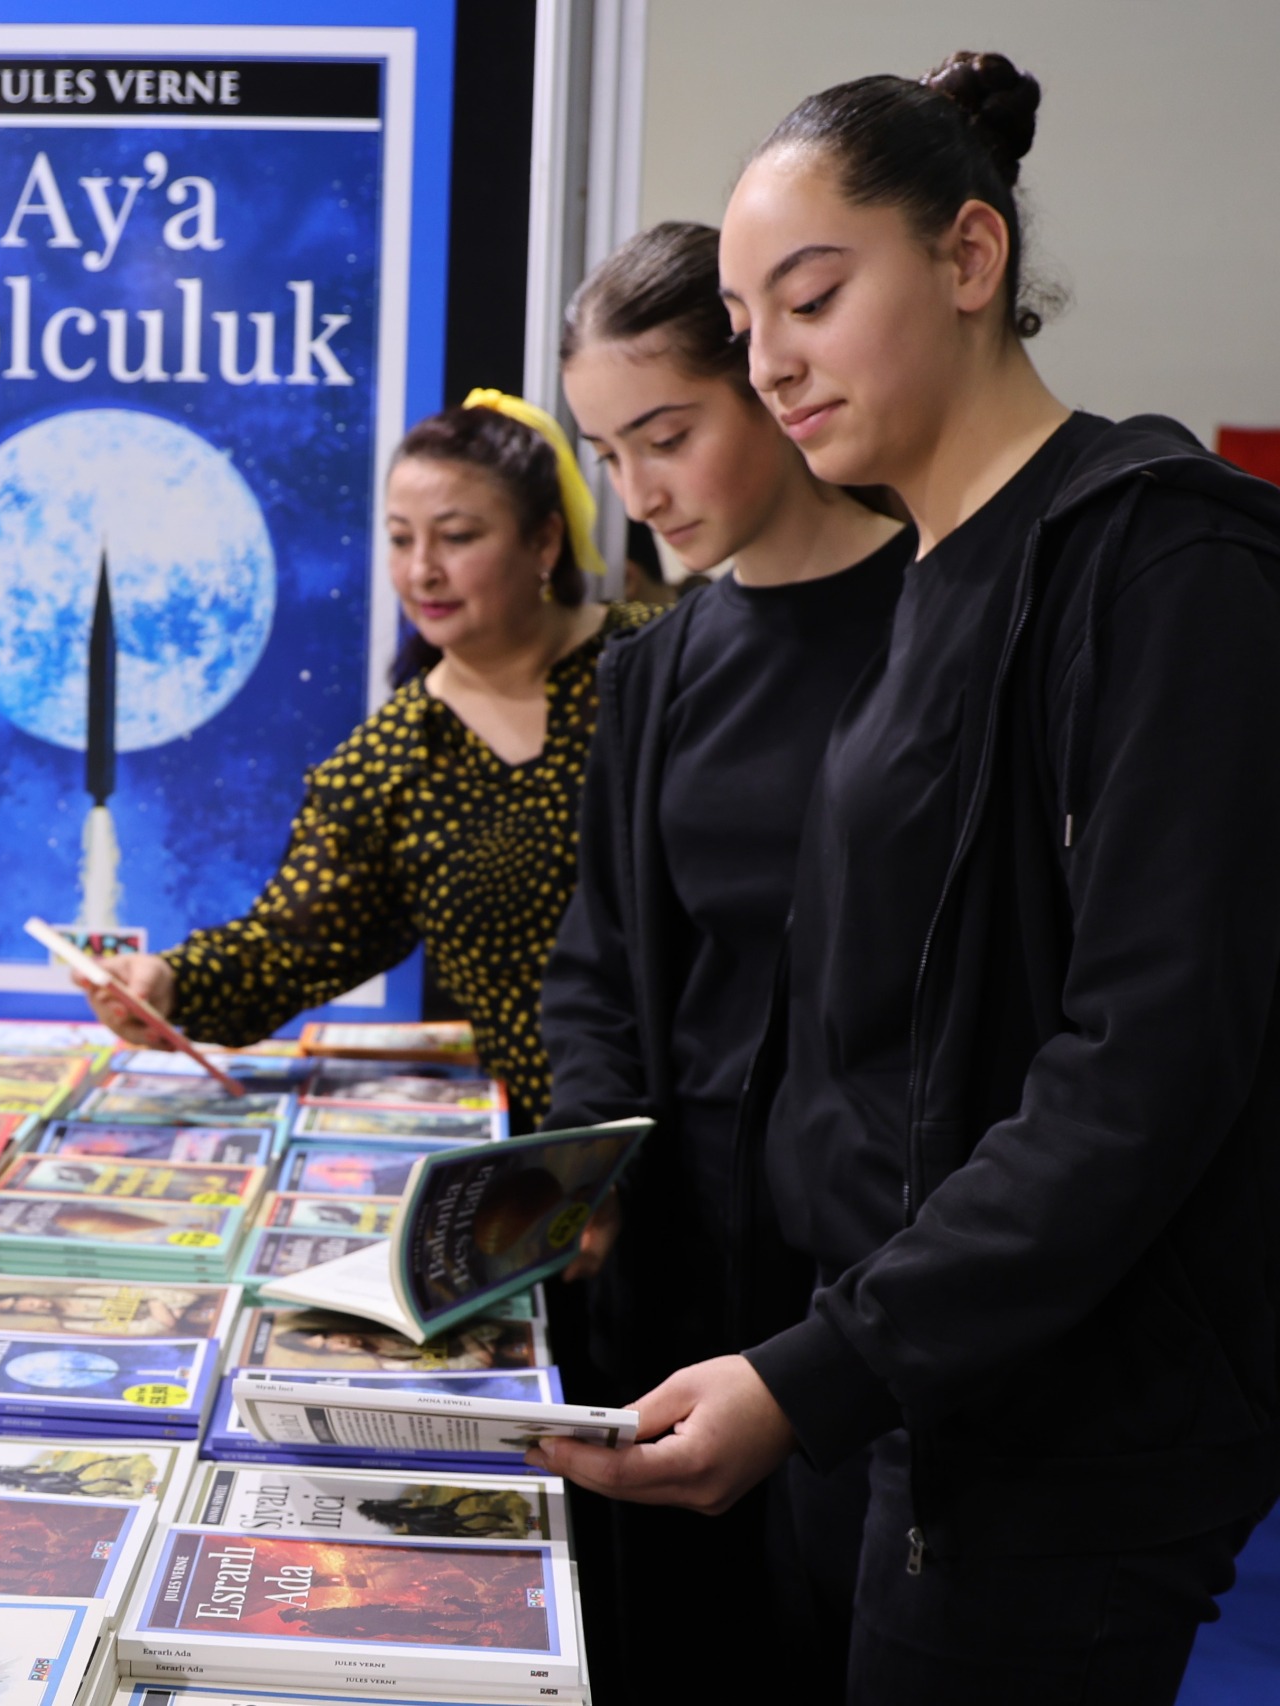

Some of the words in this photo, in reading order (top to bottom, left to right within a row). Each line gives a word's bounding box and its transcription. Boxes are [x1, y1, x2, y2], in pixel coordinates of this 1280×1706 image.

[105, 69, 241, 105] VERNE
[417, 1396, 440, 1405] ANNA
[240, 1486, 294, 1530] Siyah
[172, 1555, 190, 1581] VERNE
[164, 1579, 183, 1602] JULES
[195, 1546, 256, 1621] Esrarlı
[264, 1565, 314, 1609] Ada
[143, 1648, 172, 1657] Esrarlı
[359, 1661, 386, 1669] VERNE
[155, 1663, 185, 1672] Esrarlı
[186, 1665, 204, 1673] Ada
[345, 1676, 368, 1684] JULES
[370, 1678, 397, 1686] VERNE
